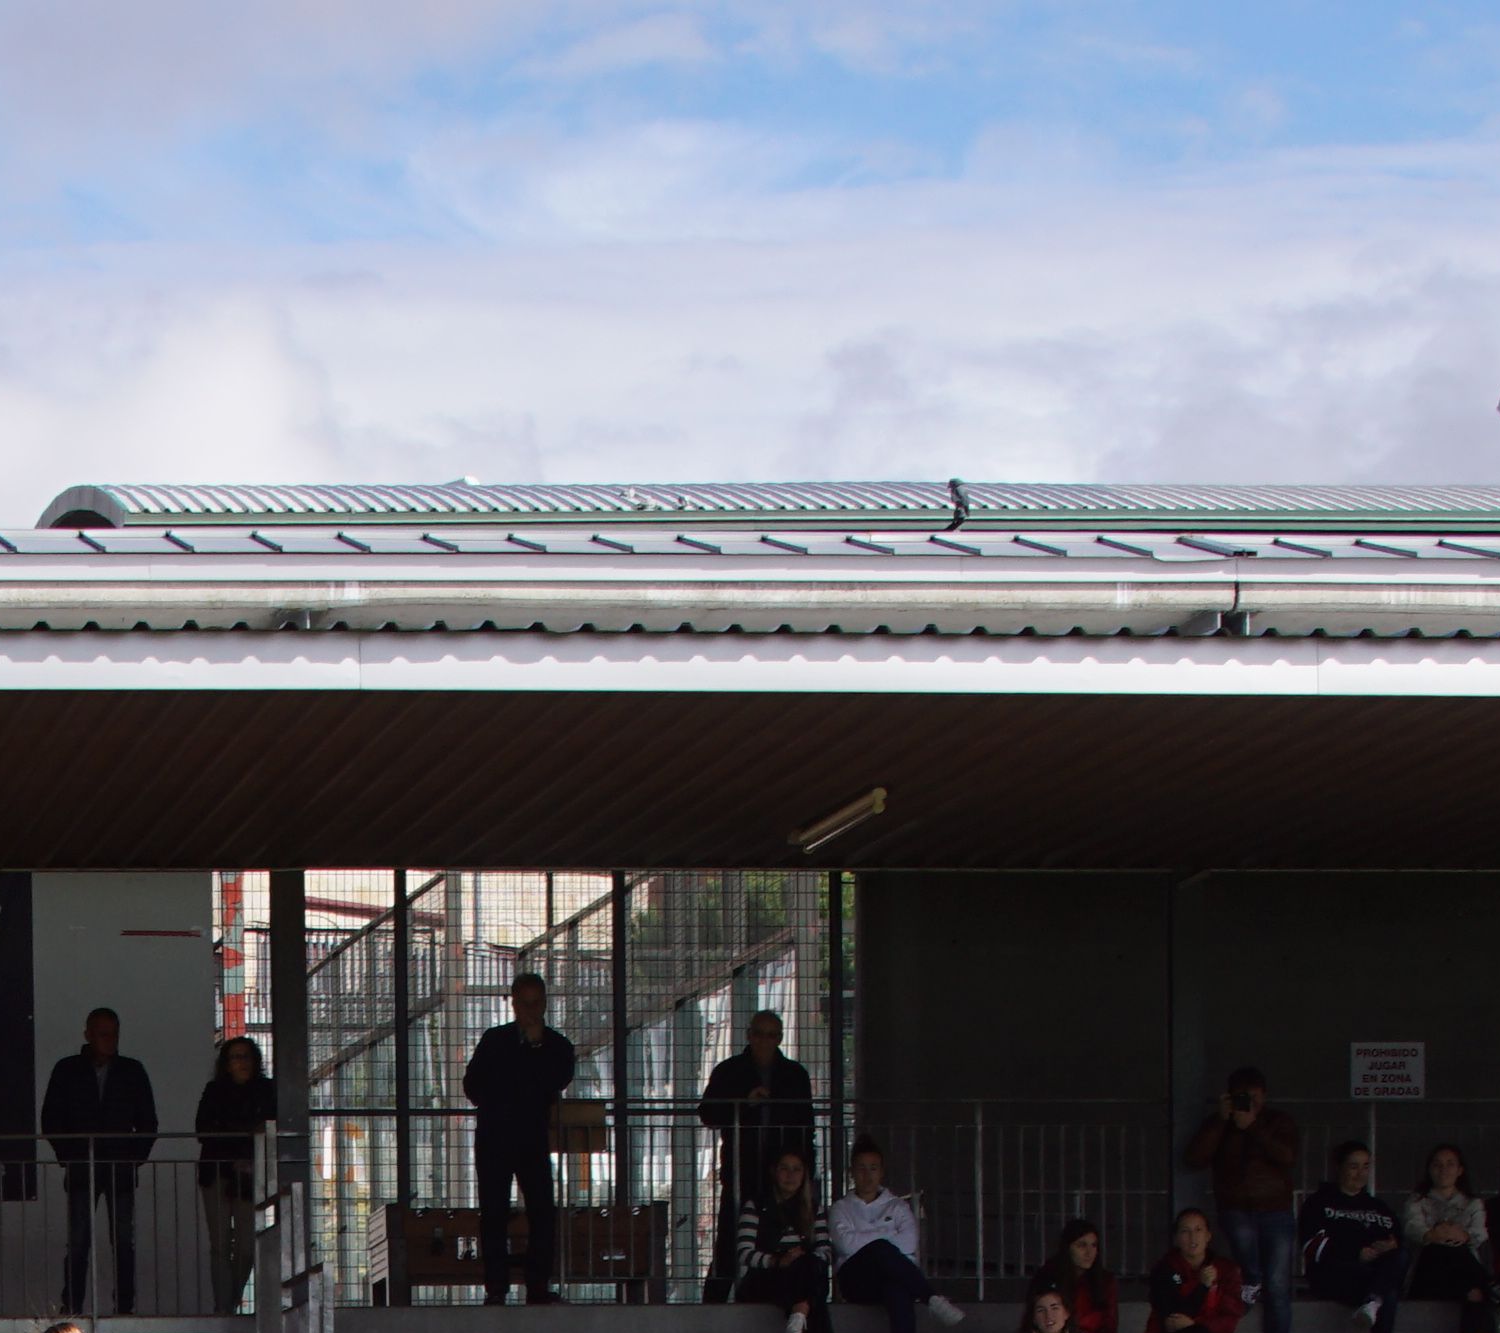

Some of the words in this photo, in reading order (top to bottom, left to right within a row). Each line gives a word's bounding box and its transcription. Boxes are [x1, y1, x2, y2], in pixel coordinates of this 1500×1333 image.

[1356, 1048, 1418, 1057] PROHIBIDO
[1368, 1061, 1406, 1070] JUGAR
[1362, 1074, 1377, 1083] EN
[1381, 1074, 1412, 1083] ZONA
[1354, 1087, 1369, 1096] DE
[1374, 1087, 1420, 1096] GRADAS
